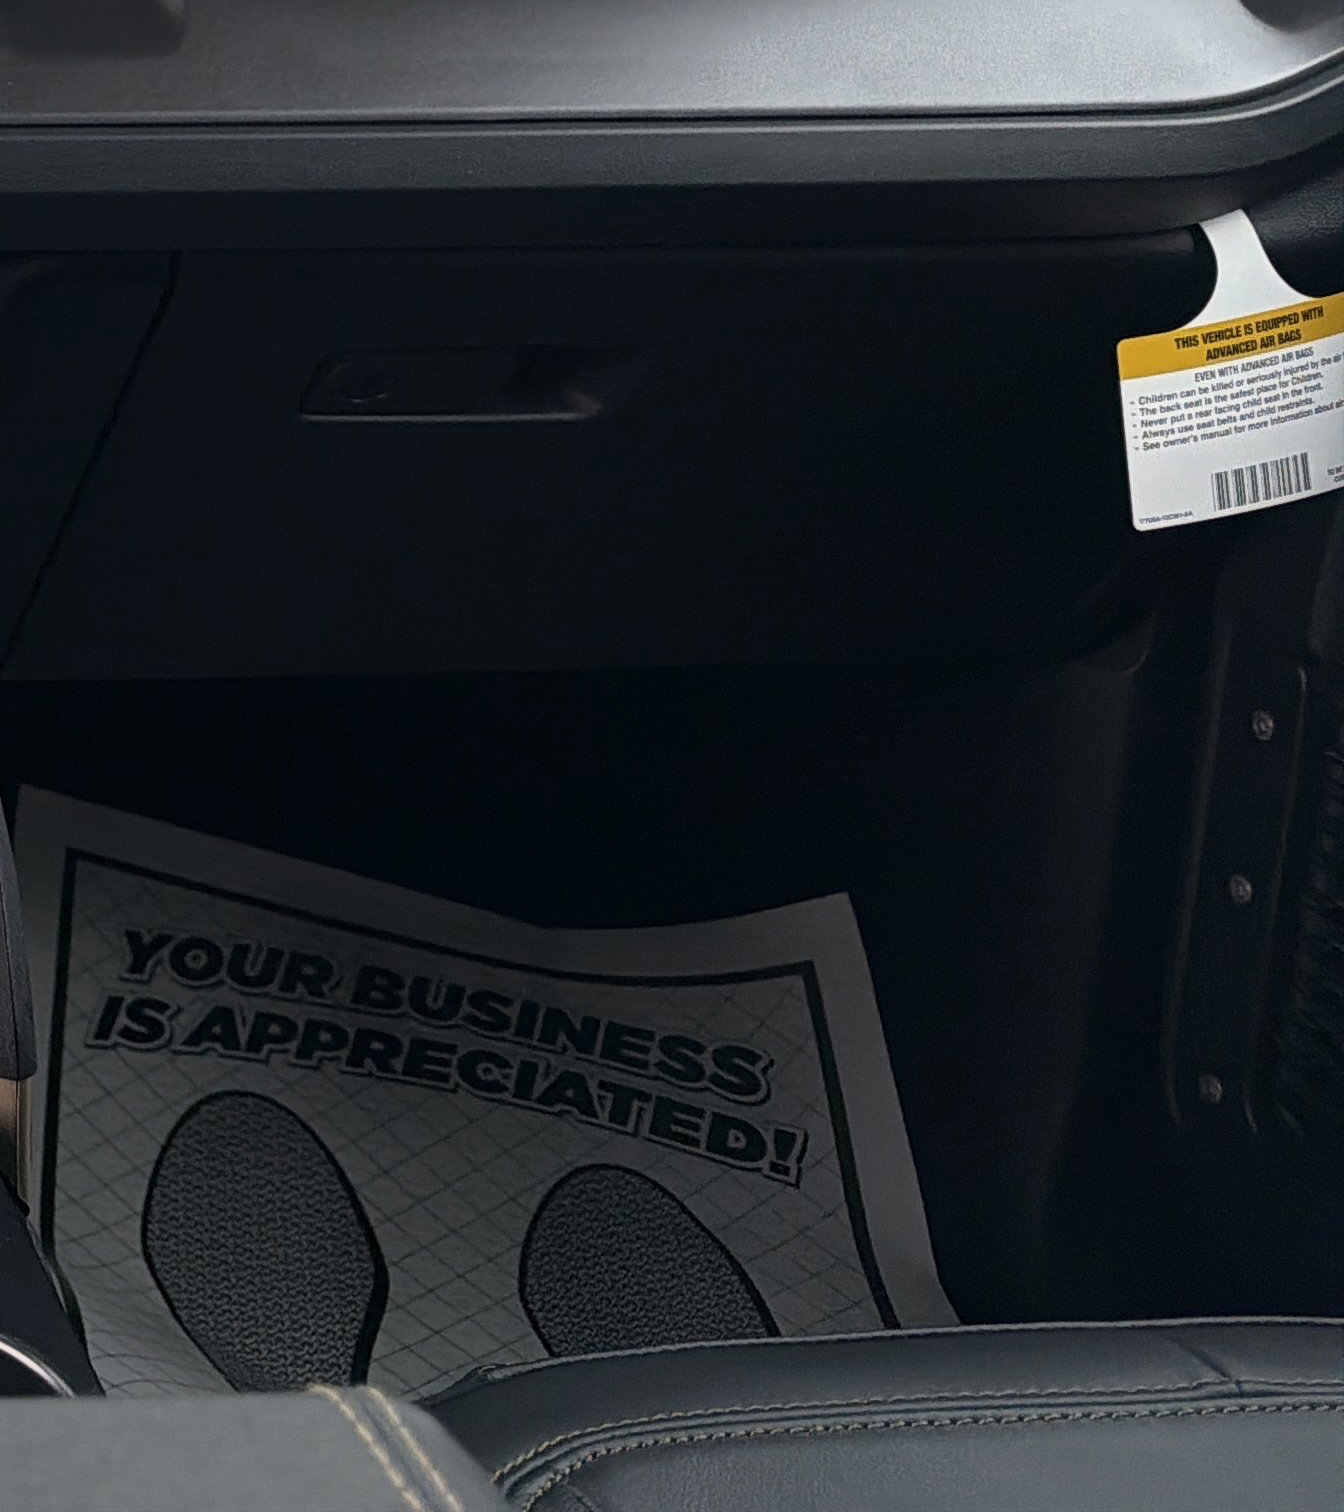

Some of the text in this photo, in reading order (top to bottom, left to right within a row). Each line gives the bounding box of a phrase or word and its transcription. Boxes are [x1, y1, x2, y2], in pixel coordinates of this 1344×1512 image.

[1174, 306, 1324, 350] THIS VEHICLE IS EQUIPPED WITH
[1206, 328, 1302, 361] ADVANCED AIR BAGS
[1138, 391, 1178, 406] Children
[1180, 390, 1196, 400] can
[1198, 386, 1209, 396] be
[1211, 379, 1234, 393] killed
[1284, 363, 1309, 377] injured
[1195, 347, 1314, 383] EVEN WITH ADVANCED AIR BAGS
[1139, 407, 1157, 418] The
[1159, 402, 1182, 414] back
[1184, 399, 1202, 409] seat
[1214, 393, 1228, 403] the
[1256, 383, 1277, 396] place
[1140, 417, 1168, 428] Never
[1170, 414, 1185, 425] put
[1195, 409, 1212, 420] rear
[1214, 404, 1241, 418] facing
[1242, 398, 1263, 410] child
[1264, 393, 1281, 404] seat
[1142, 427, 1176, 442] Always
[1178, 425, 1194, 435] use
[1196, 421, 1214, 431] seat
[1217, 415, 1238, 427] belts
[1239, 411, 1255, 421] and
[1256, 407, 1277, 419] child
[1143, 441, 1161, 452] See
[1162, 434, 1199, 448] owner's
[1200, 427, 1233, 441] manual
[1247, 420, 1269, 431] more
[1270, 408, 1313, 425] information
[122, 928, 772, 1098] YOUR BUSINESS
[95, 994, 807, 1180] IS APPRECIATED!
